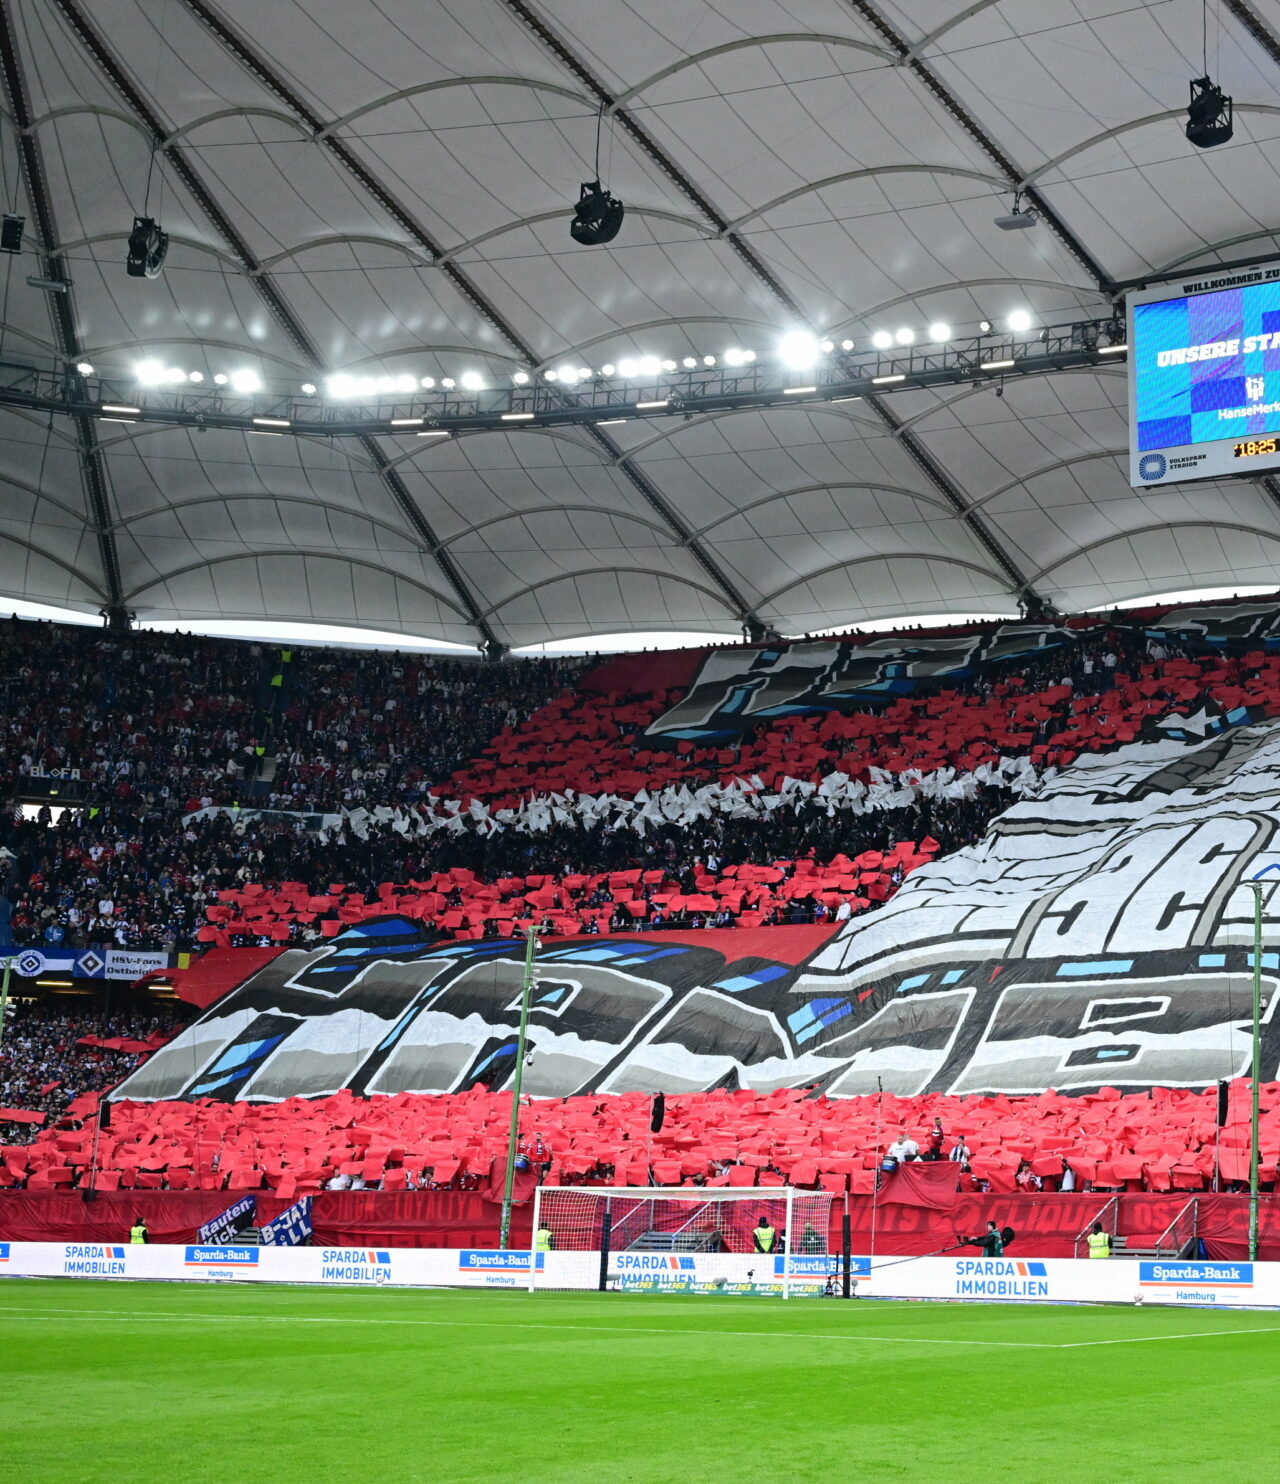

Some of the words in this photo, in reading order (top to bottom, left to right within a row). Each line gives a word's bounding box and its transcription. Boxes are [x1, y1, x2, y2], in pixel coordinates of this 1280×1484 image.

[1183, 272, 1262, 294] WILLKOMMEN
[1157, 338, 1240, 368] UNSERE
[1239, 438, 1277, 457] 18:25
[1169, 453, 1206, 464] VOLKSPARK
[1169, 461, 1197, 470] STADION
[112, 956, 162, 965] HSV-Fans
[200, 1199, 254, 1241] Rauten-
[260, 1196, 308, 1244] B-JAY
[65, 1246, 104, 1258] SPARDA
[193, 1249, 251, 1262] Sparda-Bank
[322, 1250, 367, 1264] SPARDA
[64, 1261, 125, 1274] IMMOBILIEN
[617, 1255, 667, 1270] SPARDA
[956, 1261, 1014, 1276] SPARDA
[207, 1269, 234, 1278] Hamburg
[322, 1266, 391, 1281] IMMOBILIEN
[1152, 1265, 1240, 1281] Sparda-Bank
[485, 1276, 515, 1285] Hamburg
[624, 1281, 654, 1289] bet365
[657, 1281, 686, 1290] bet365
[689, 1282, 718, 1290] bet365
[722, 1283, 752, 1291] bet365
[755, 1284, 784, 1292] bet365
[789, 1285, 818, 1293] bet365
[956, 1281, 1048, 1296] IMMOBILIEN
[1176, 1290, 1216, 1302] Hamburg
